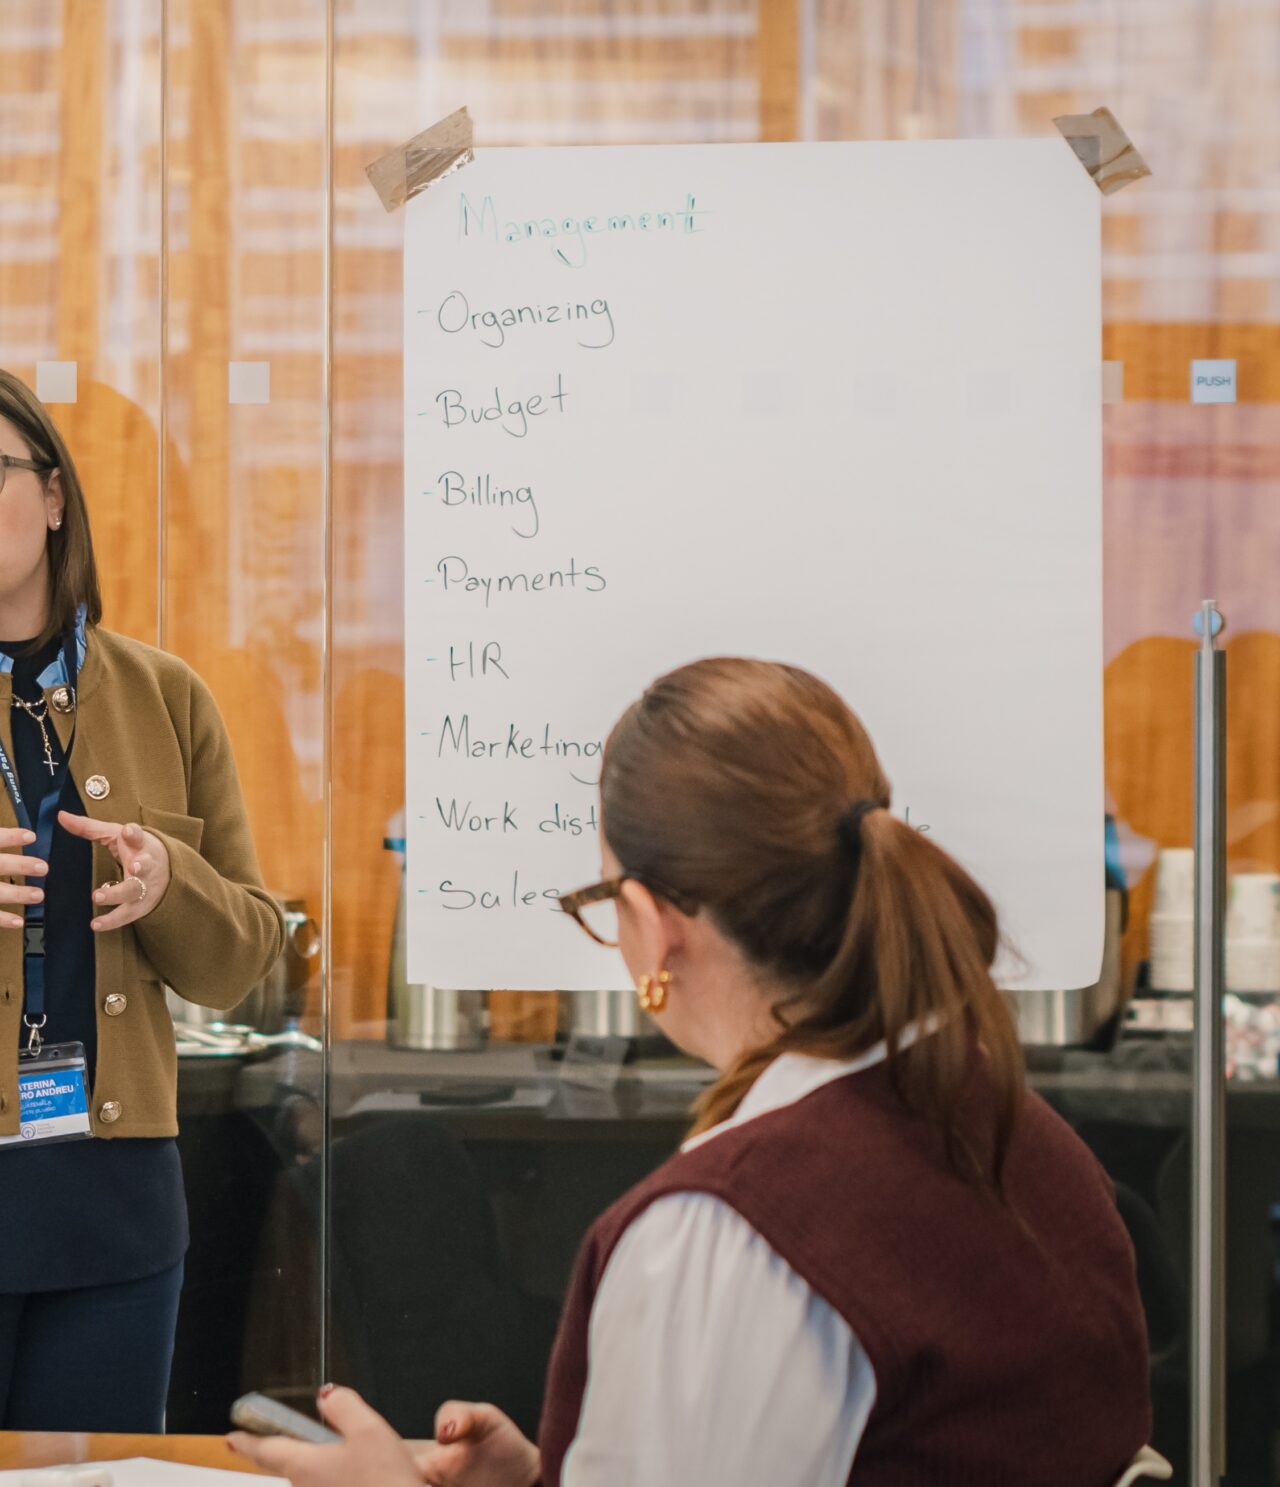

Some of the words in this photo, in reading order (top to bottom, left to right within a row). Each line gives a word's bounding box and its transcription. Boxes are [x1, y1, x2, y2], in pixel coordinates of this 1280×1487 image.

[459, 192, 712, 268] Management
[1196, 375, 1231, 387] PUSH
[6, 771, 22, 804] Young
[538, 802, 598, 836] dist
[20, 1091, 34, 1100] RO
[35, 1085, 74, 1098] ANDREU
